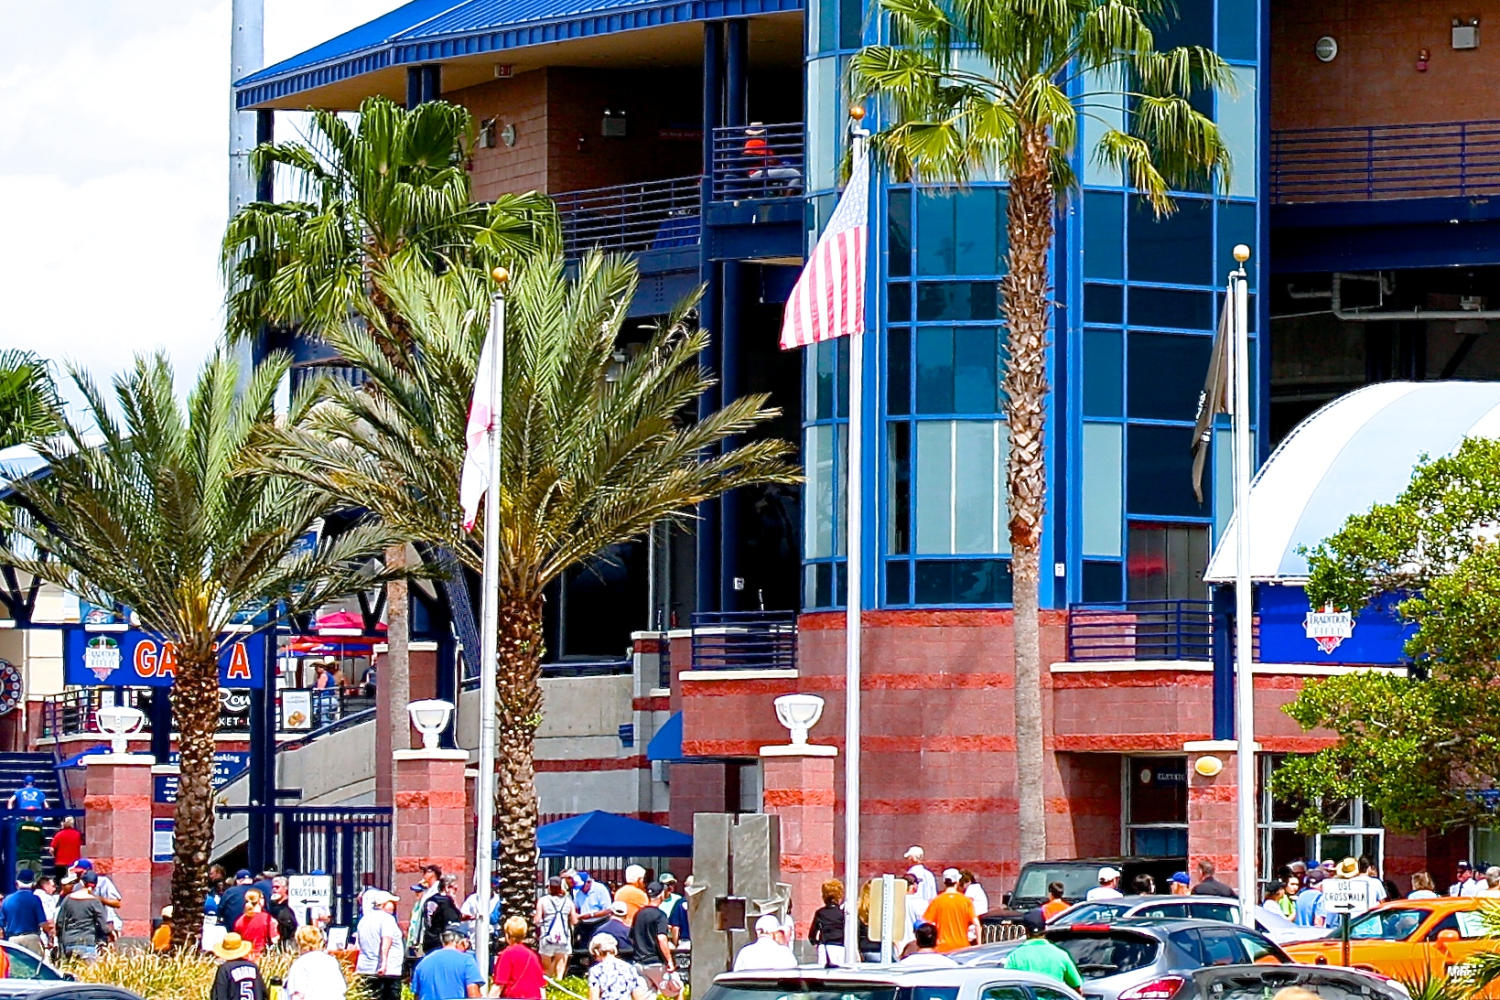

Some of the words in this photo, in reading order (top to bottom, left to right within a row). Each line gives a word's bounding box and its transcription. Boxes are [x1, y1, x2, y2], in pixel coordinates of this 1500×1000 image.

[227, 641, 252, 680] A
[290, 888, 327, 897] CROSSWALK
[1324, 892, 1366, 901] CROSSWALK
[240, 980, 256, 1000] 5
